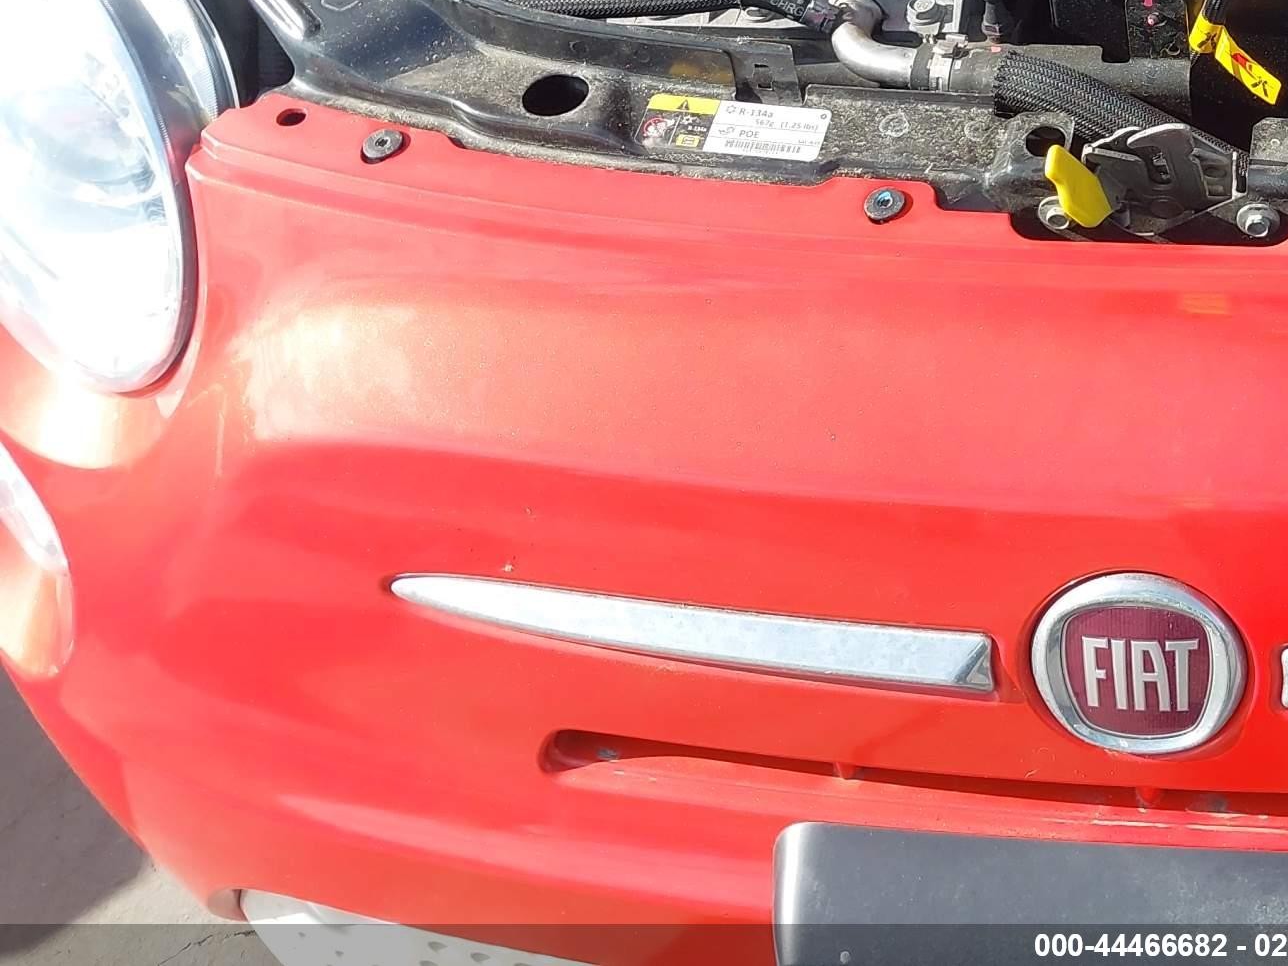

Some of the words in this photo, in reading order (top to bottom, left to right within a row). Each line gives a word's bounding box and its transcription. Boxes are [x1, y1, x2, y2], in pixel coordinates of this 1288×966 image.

[738, 108, 774, 119] R-134a
[739, 129, 760, 139] POE
[1082, 636, 1199, 712] FIAT
